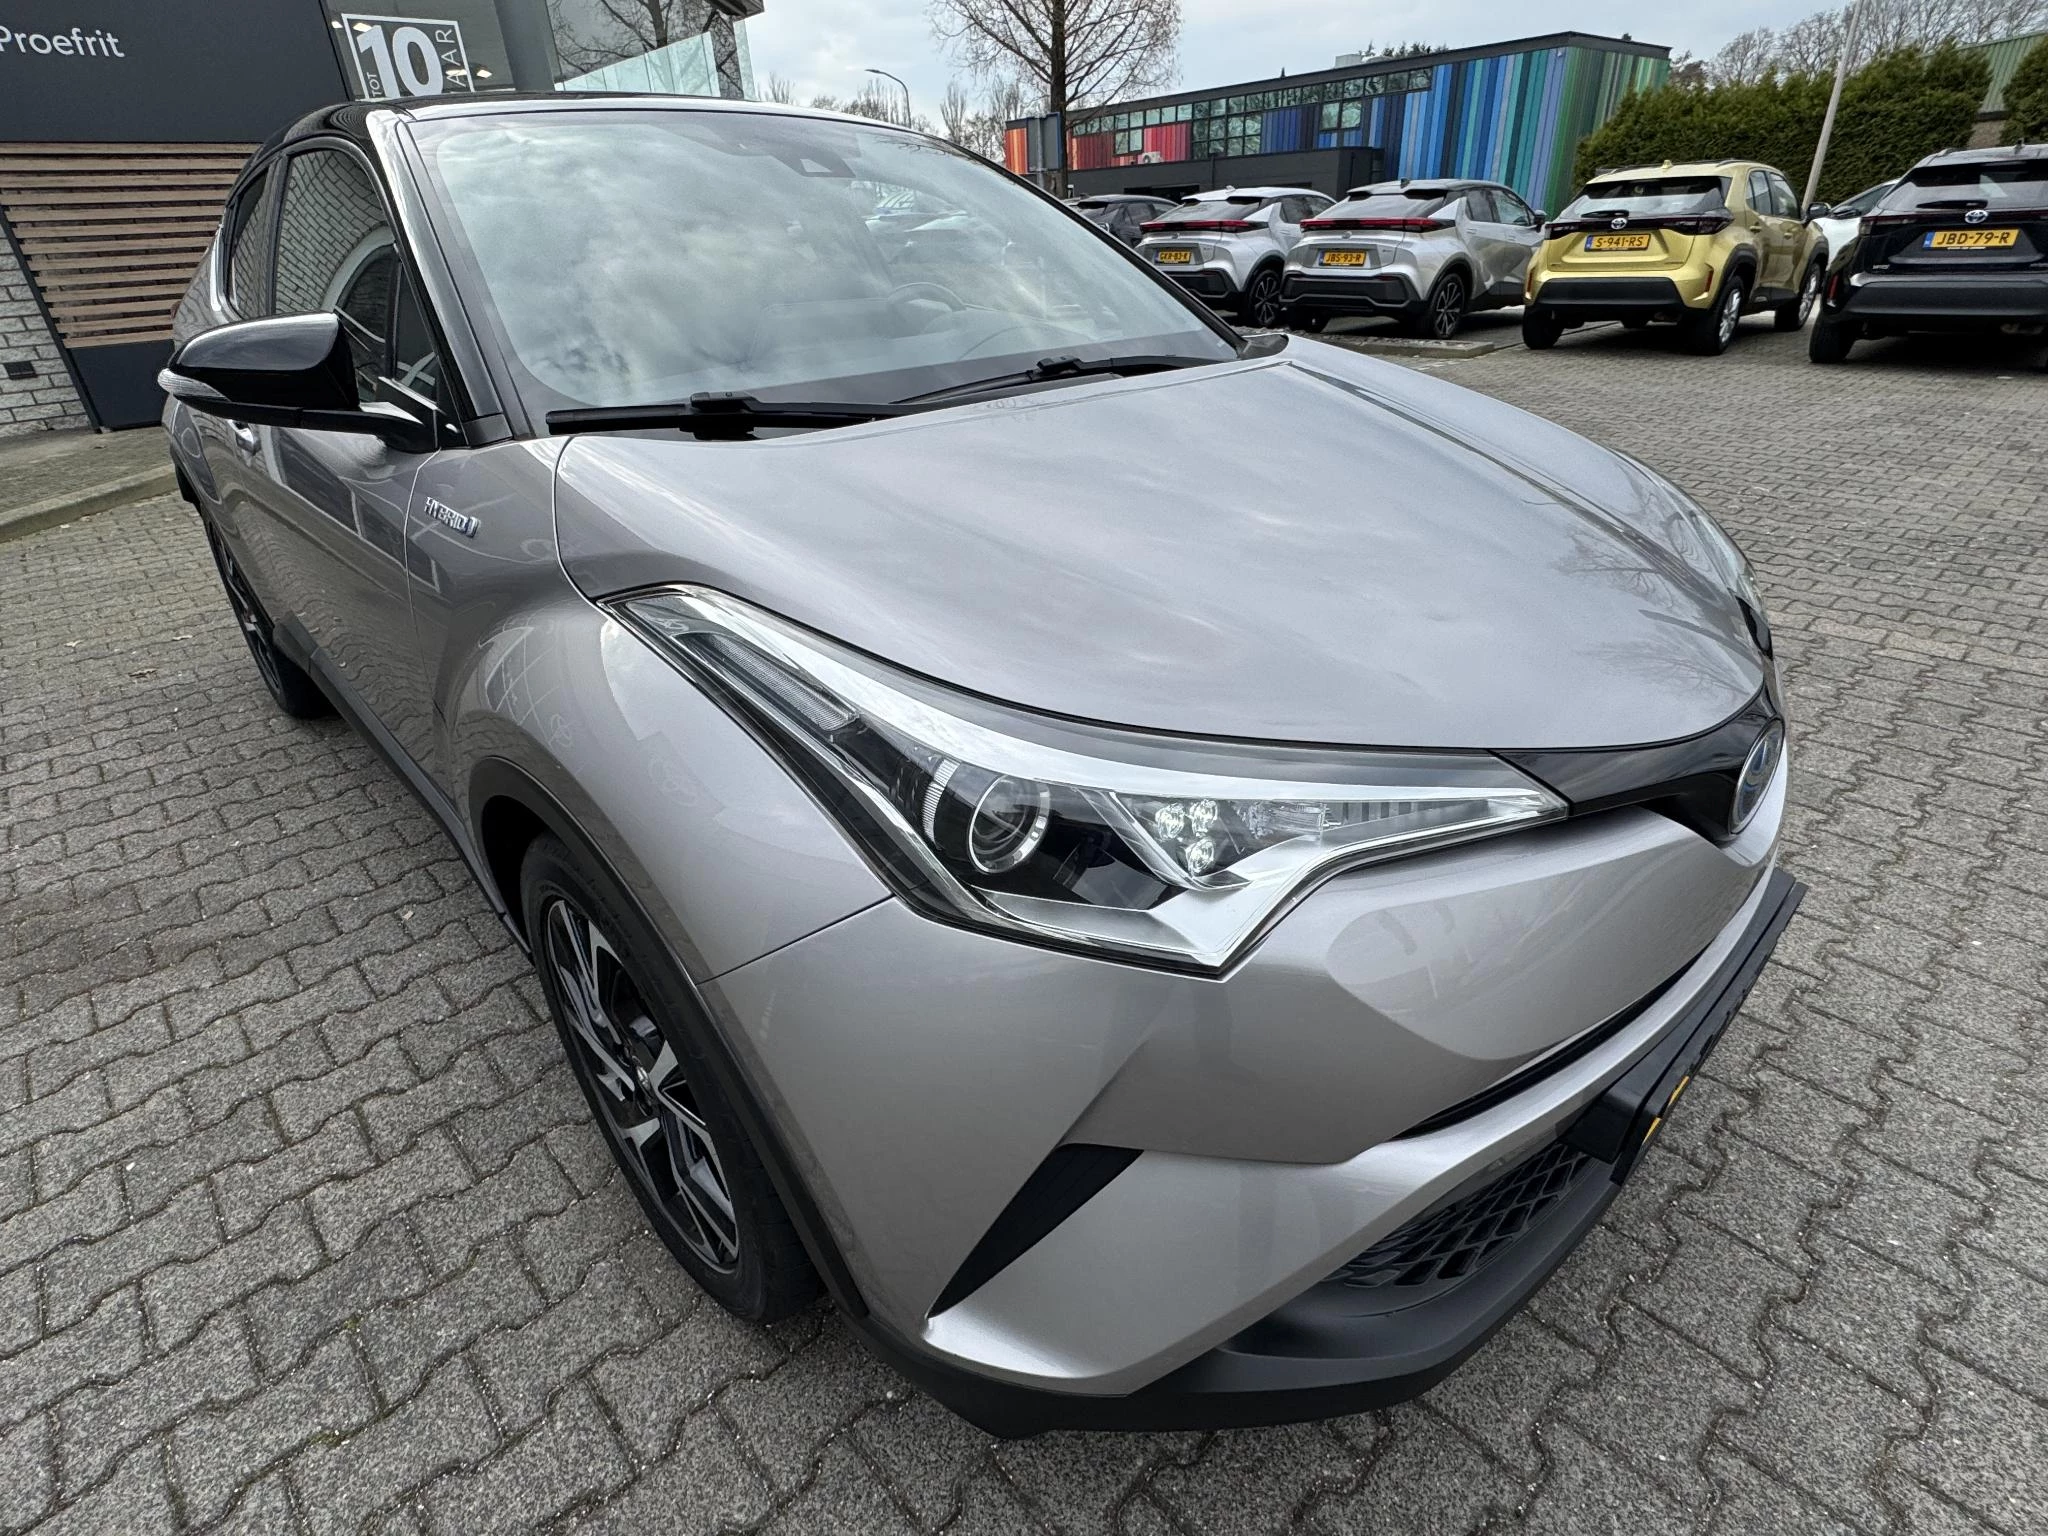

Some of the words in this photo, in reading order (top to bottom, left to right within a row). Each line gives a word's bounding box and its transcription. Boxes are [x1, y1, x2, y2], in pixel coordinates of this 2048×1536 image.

[0, 25, 125, 58] Proefrit
[356, 24, 444, 98] 10
[366, 71, 382, 98] TOT
[1595, 236, 1644, 248] S-941-RS
[1937, 231, 2011, 245] JBD-79-R
[1326, 253, 1362, 262] JBS-93-R
[424, 496, 470, 532] HYBRID
